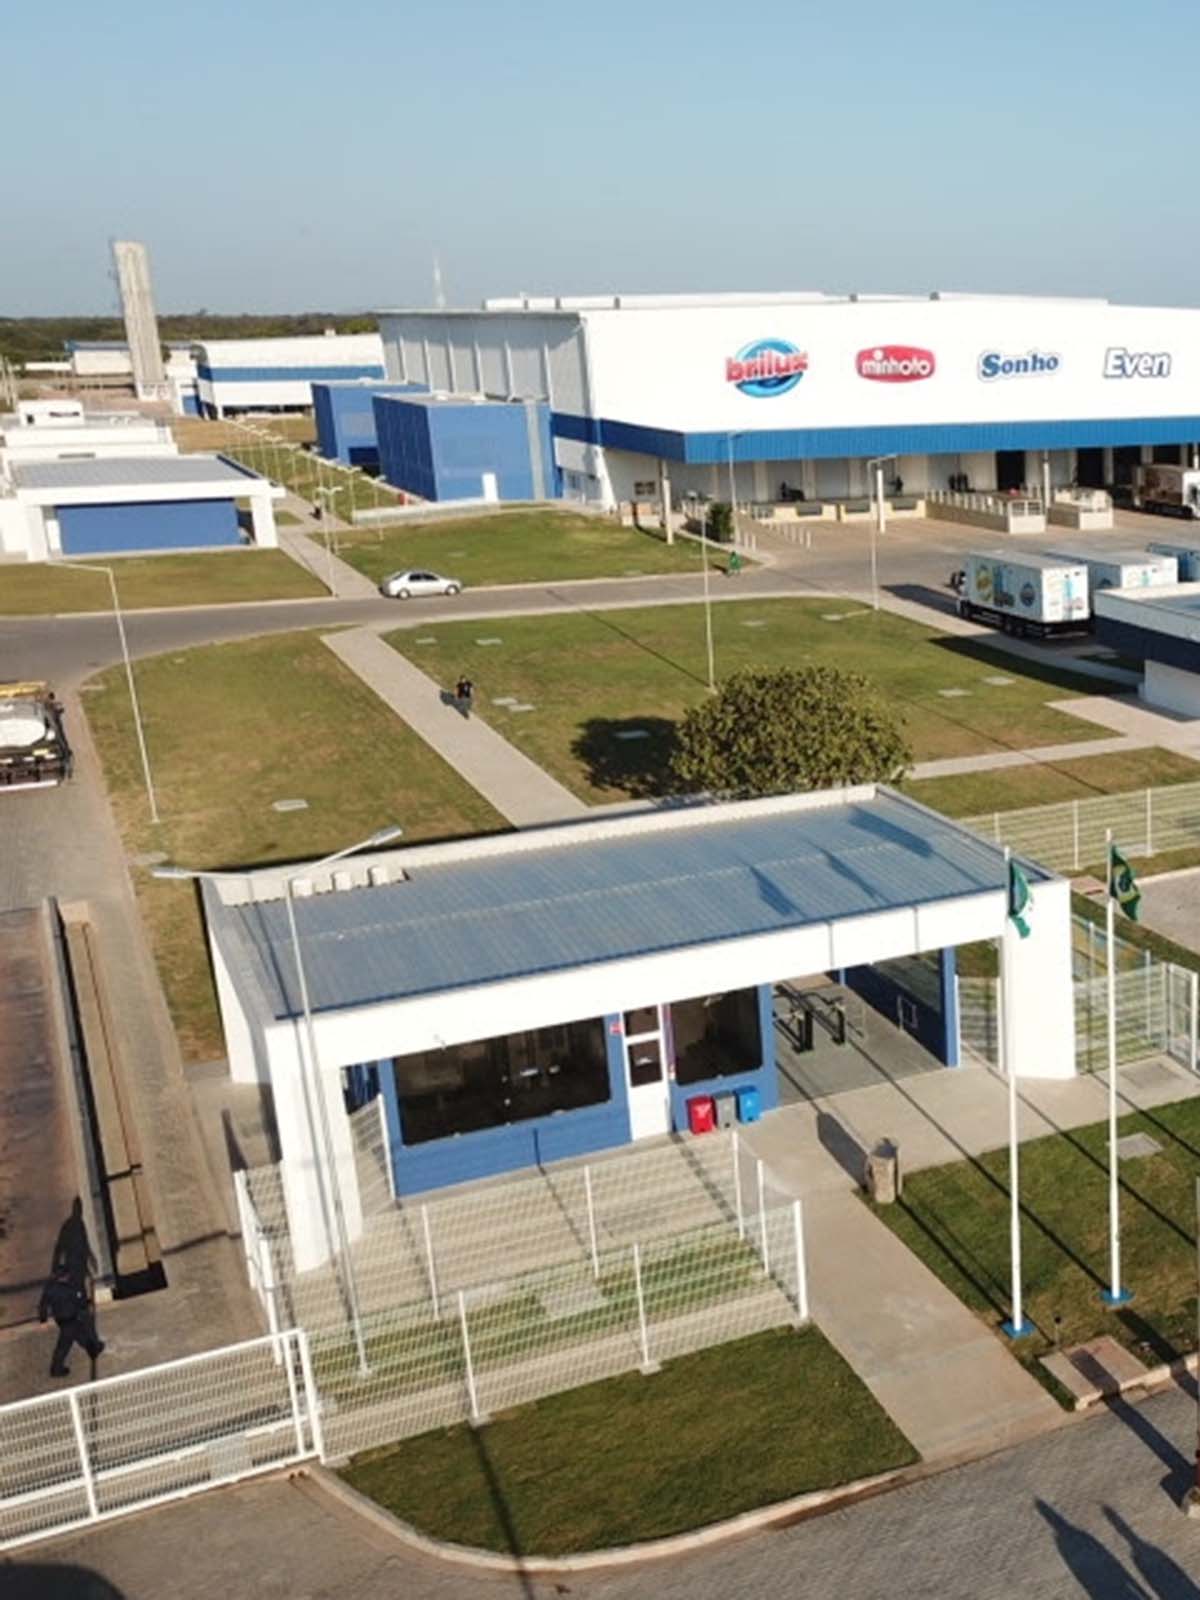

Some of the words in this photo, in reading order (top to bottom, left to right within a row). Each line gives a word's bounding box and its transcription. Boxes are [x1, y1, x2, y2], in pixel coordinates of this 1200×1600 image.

[862, 350, 930, 376] minhoto
[980, 351, 1060, 379] Sonho
[1104, 347, 1171, 378] Even
